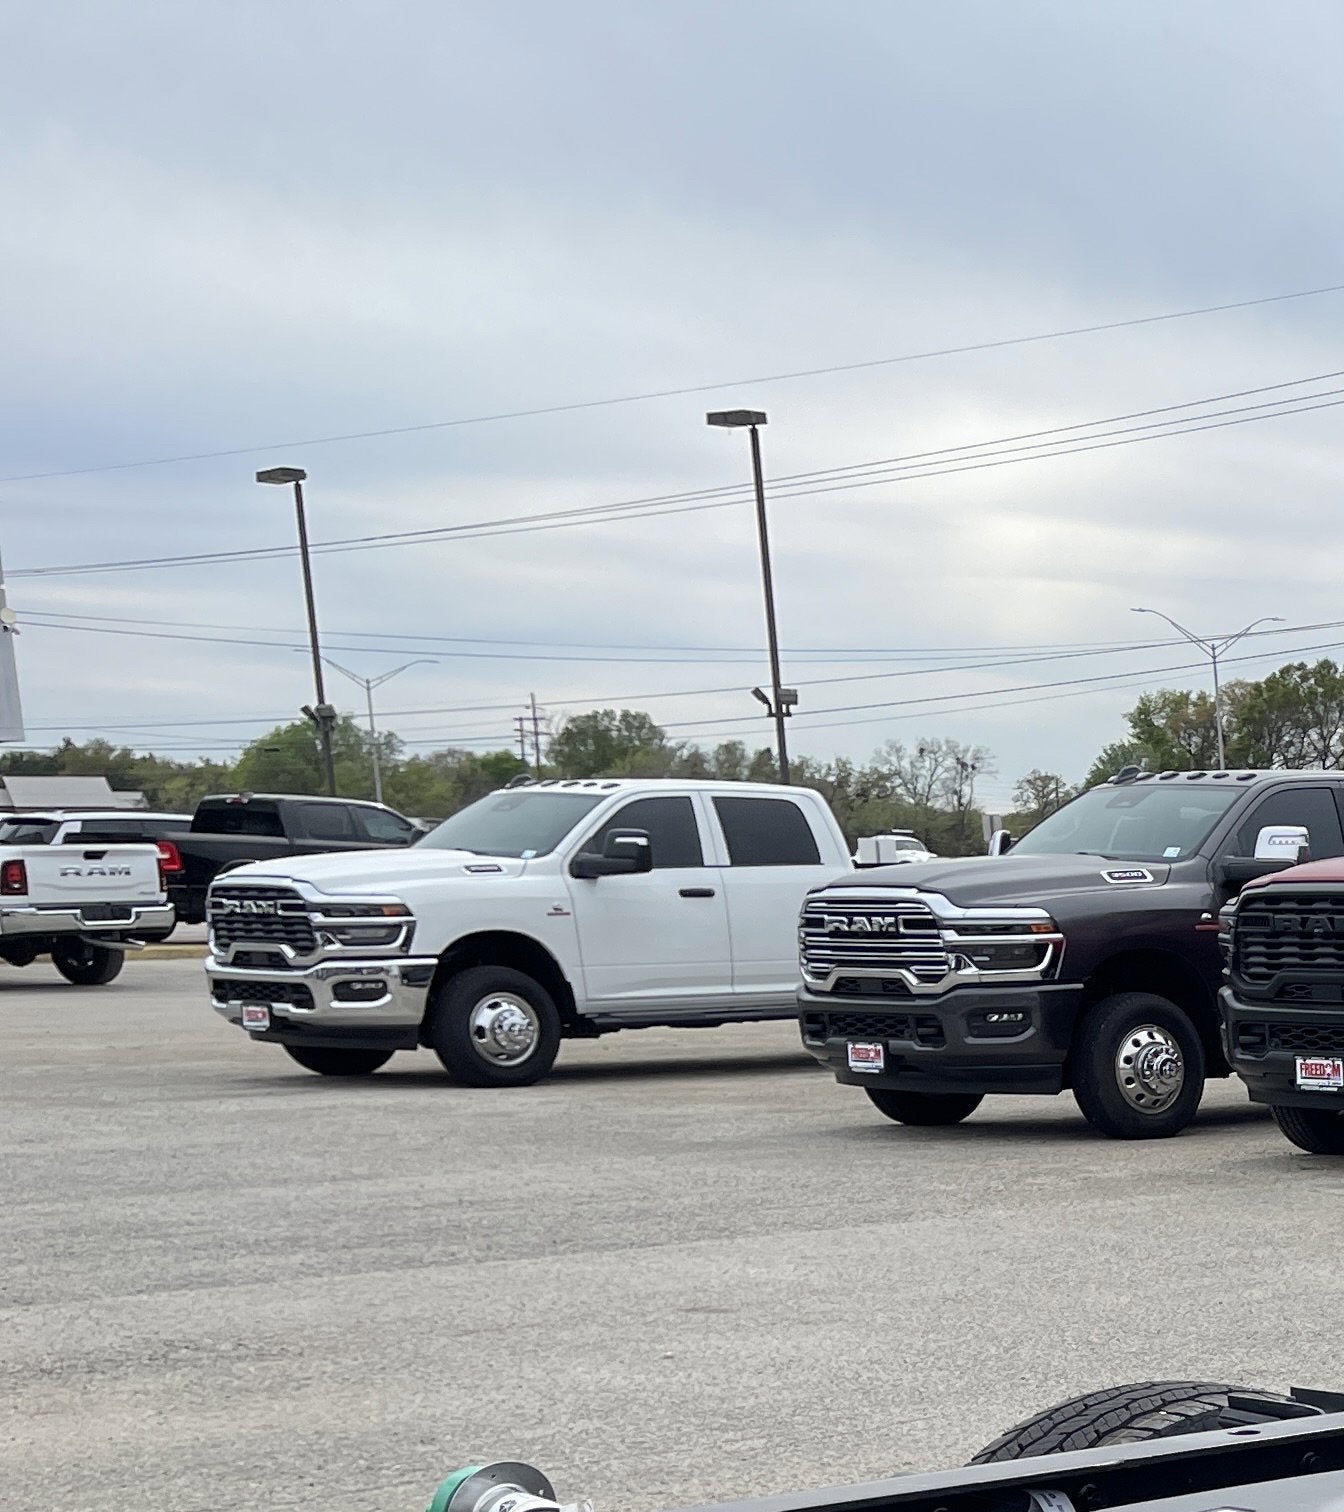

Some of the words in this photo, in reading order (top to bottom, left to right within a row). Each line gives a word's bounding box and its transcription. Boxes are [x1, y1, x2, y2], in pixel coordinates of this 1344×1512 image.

[59, 865, 132, 877] RAM
[222, 899, 275, 914] RAM
[824, 915, 896, 933] RAM
